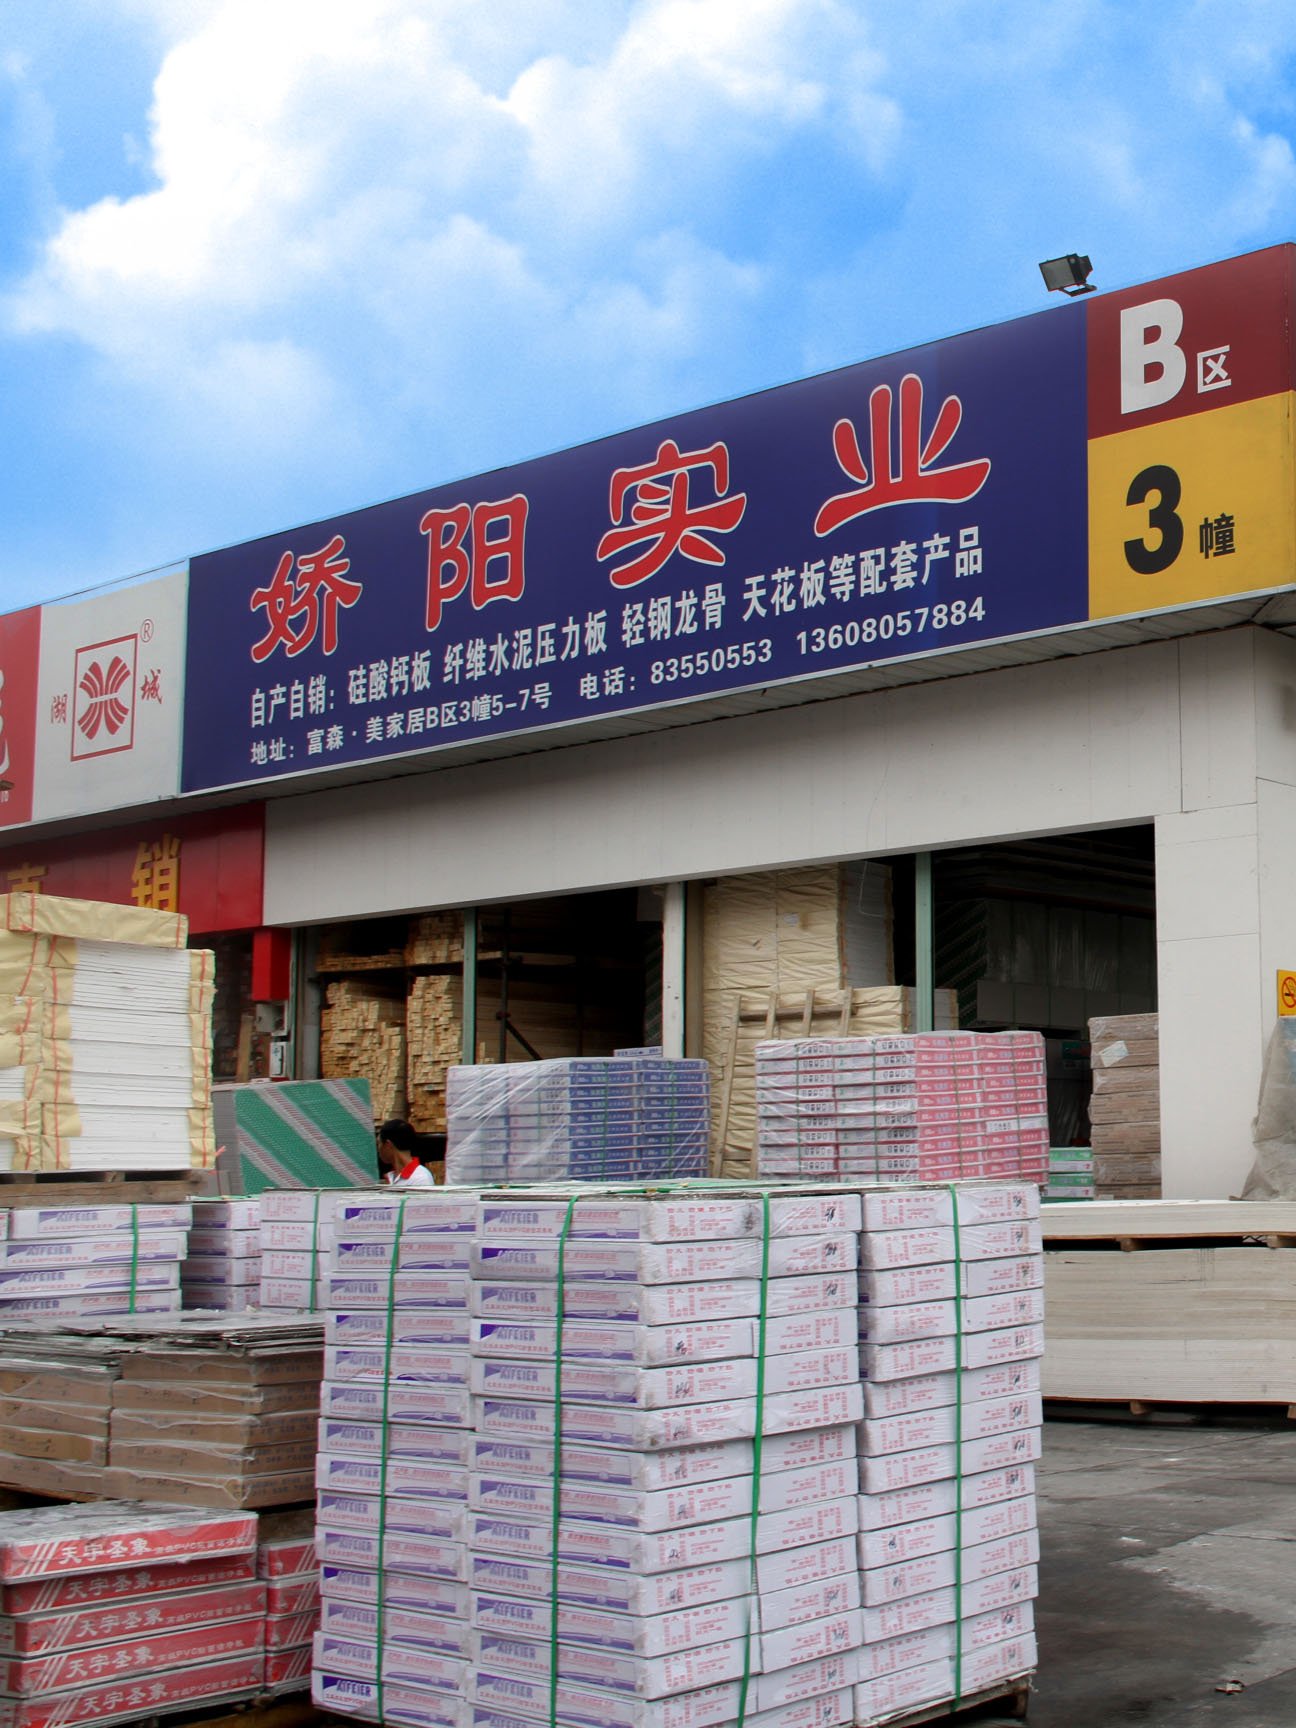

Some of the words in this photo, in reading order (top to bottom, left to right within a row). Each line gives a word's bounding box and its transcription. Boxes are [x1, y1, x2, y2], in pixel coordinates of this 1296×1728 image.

[1120, 298, 1232, 414] B区
[250, 373, 991, 663] 娇阳实业
[1123, 465, 1236, 575] 3幢
[443, 610, 608, 685] 纤维水泥压力板
[621, 582, 726, 648] 轻钢龙骨
[742, 526, 983, 622] 天花板等配套产品
[796, 596, 985, 655] 13608057884
